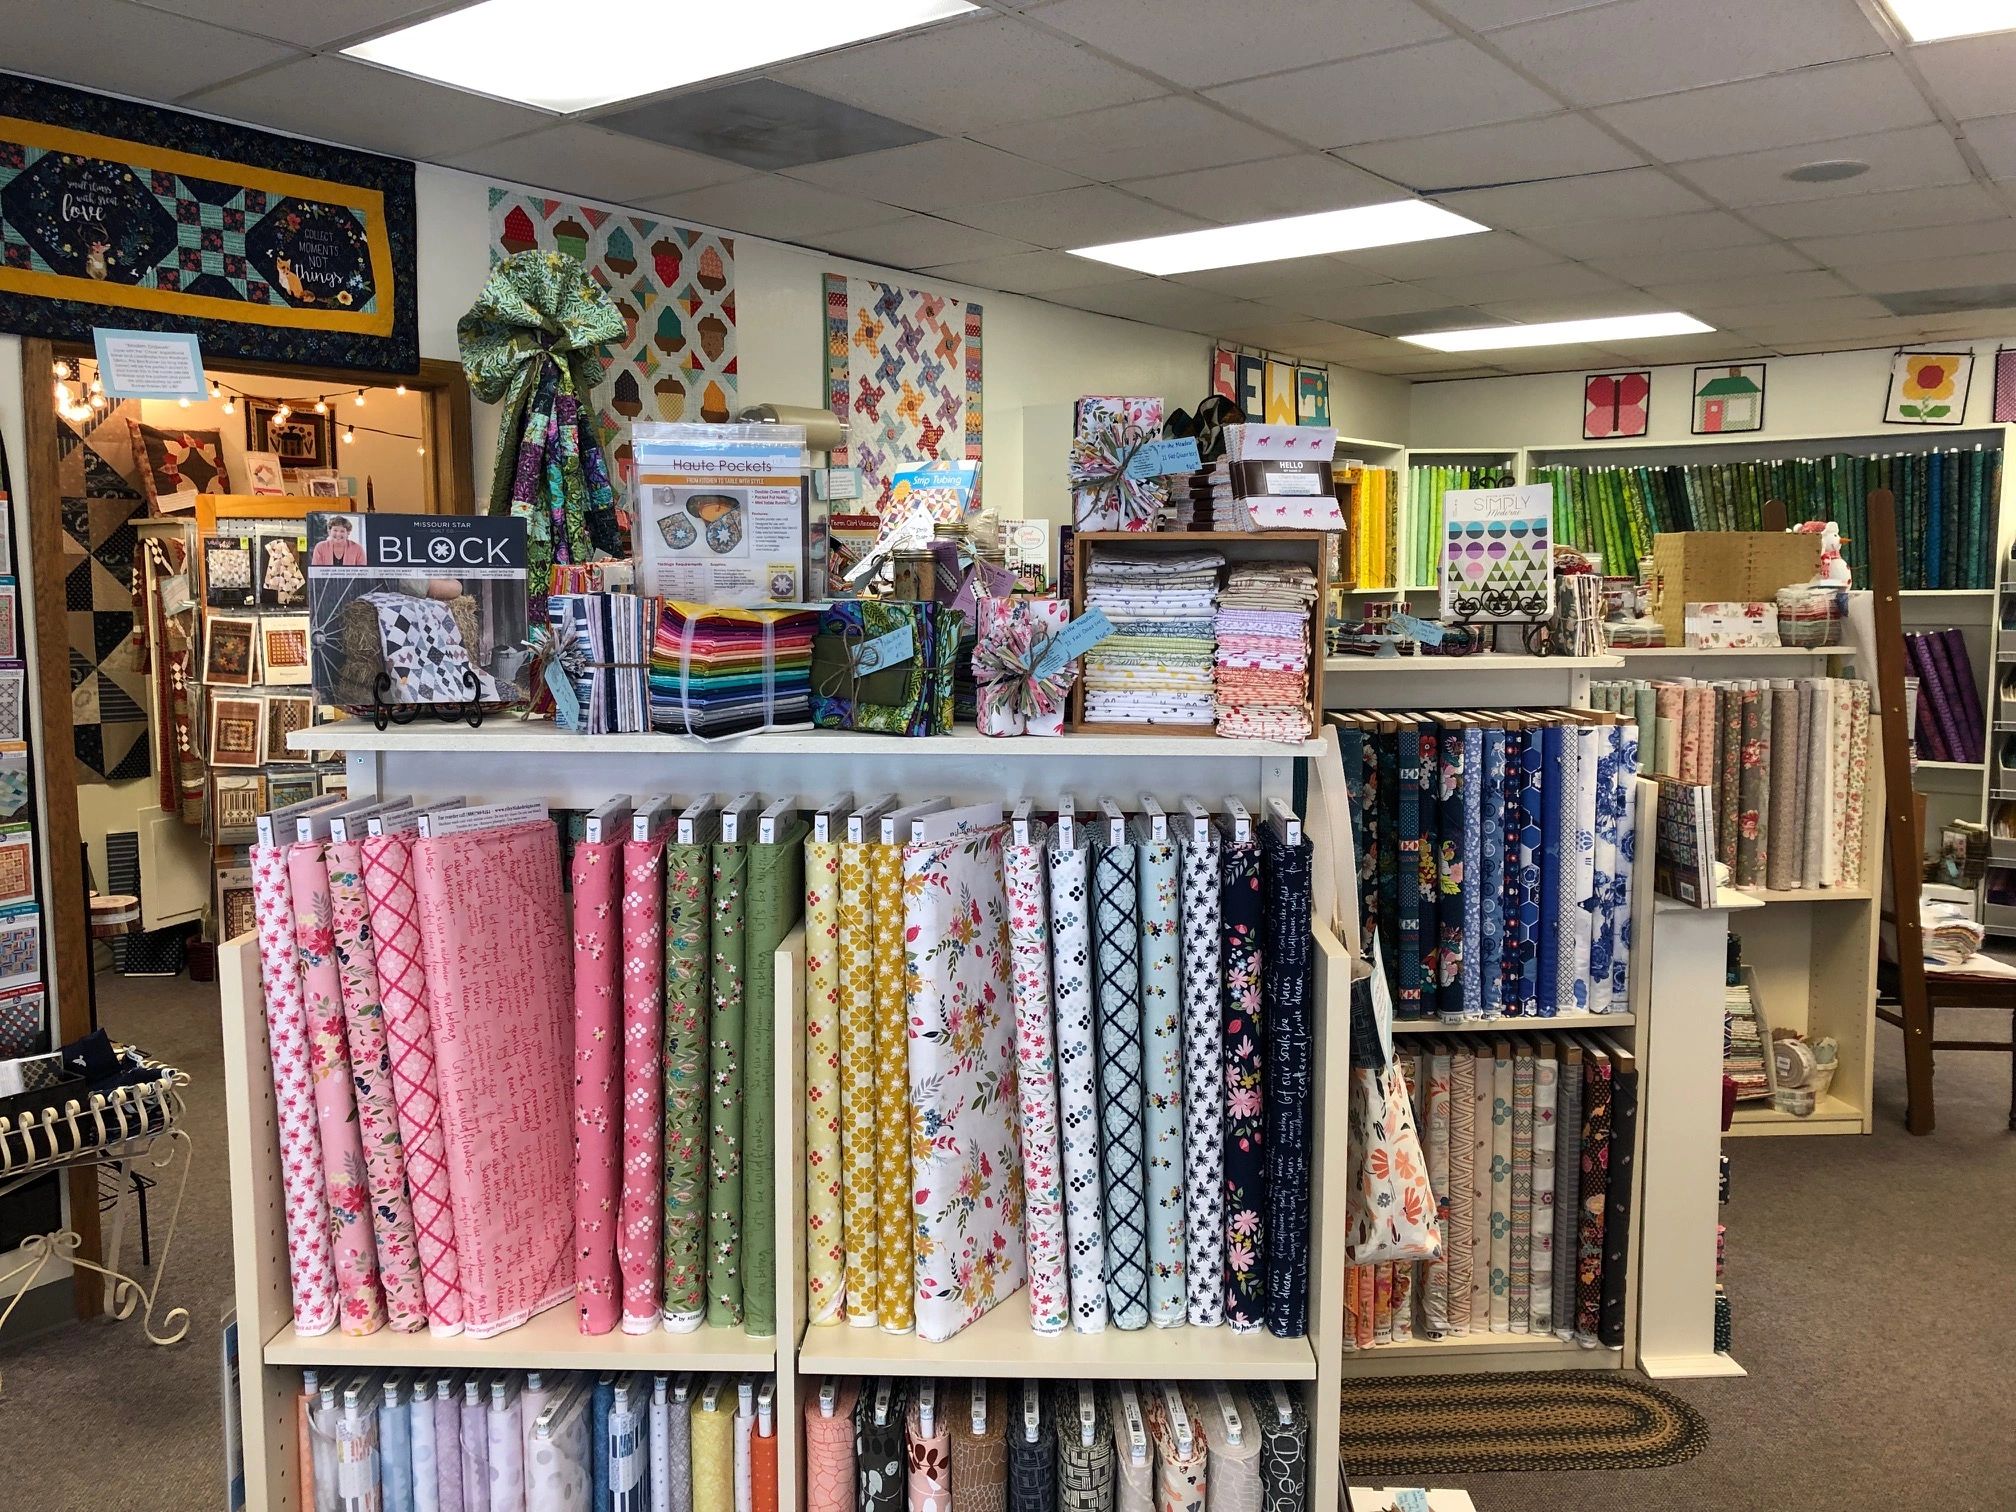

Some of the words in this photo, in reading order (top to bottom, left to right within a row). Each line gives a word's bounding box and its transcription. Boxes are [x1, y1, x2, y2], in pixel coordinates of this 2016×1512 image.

[62, 193, 106, 221] love
[304, 229, 334, 241] COLLECT
[299, 241, 339, 257] MOMENTS
[308, 255, 329, 268] NOT
[295, 263, 344, 288] things
[673, 459, 715, 471] Haute
[719, 460, 772, 472] Pockets
[1279, 461, 1304, 469] HELLO
[912, 475, 930, 486] Strip
[933, 475, 962, 486] Tubing
[1473, 495, 1531, 511] SIMPLY
[846, 519, 858, 527] Girl
[858, 519, 880, 528] Vintage
[378, 536, 511, 564] BLOCK
